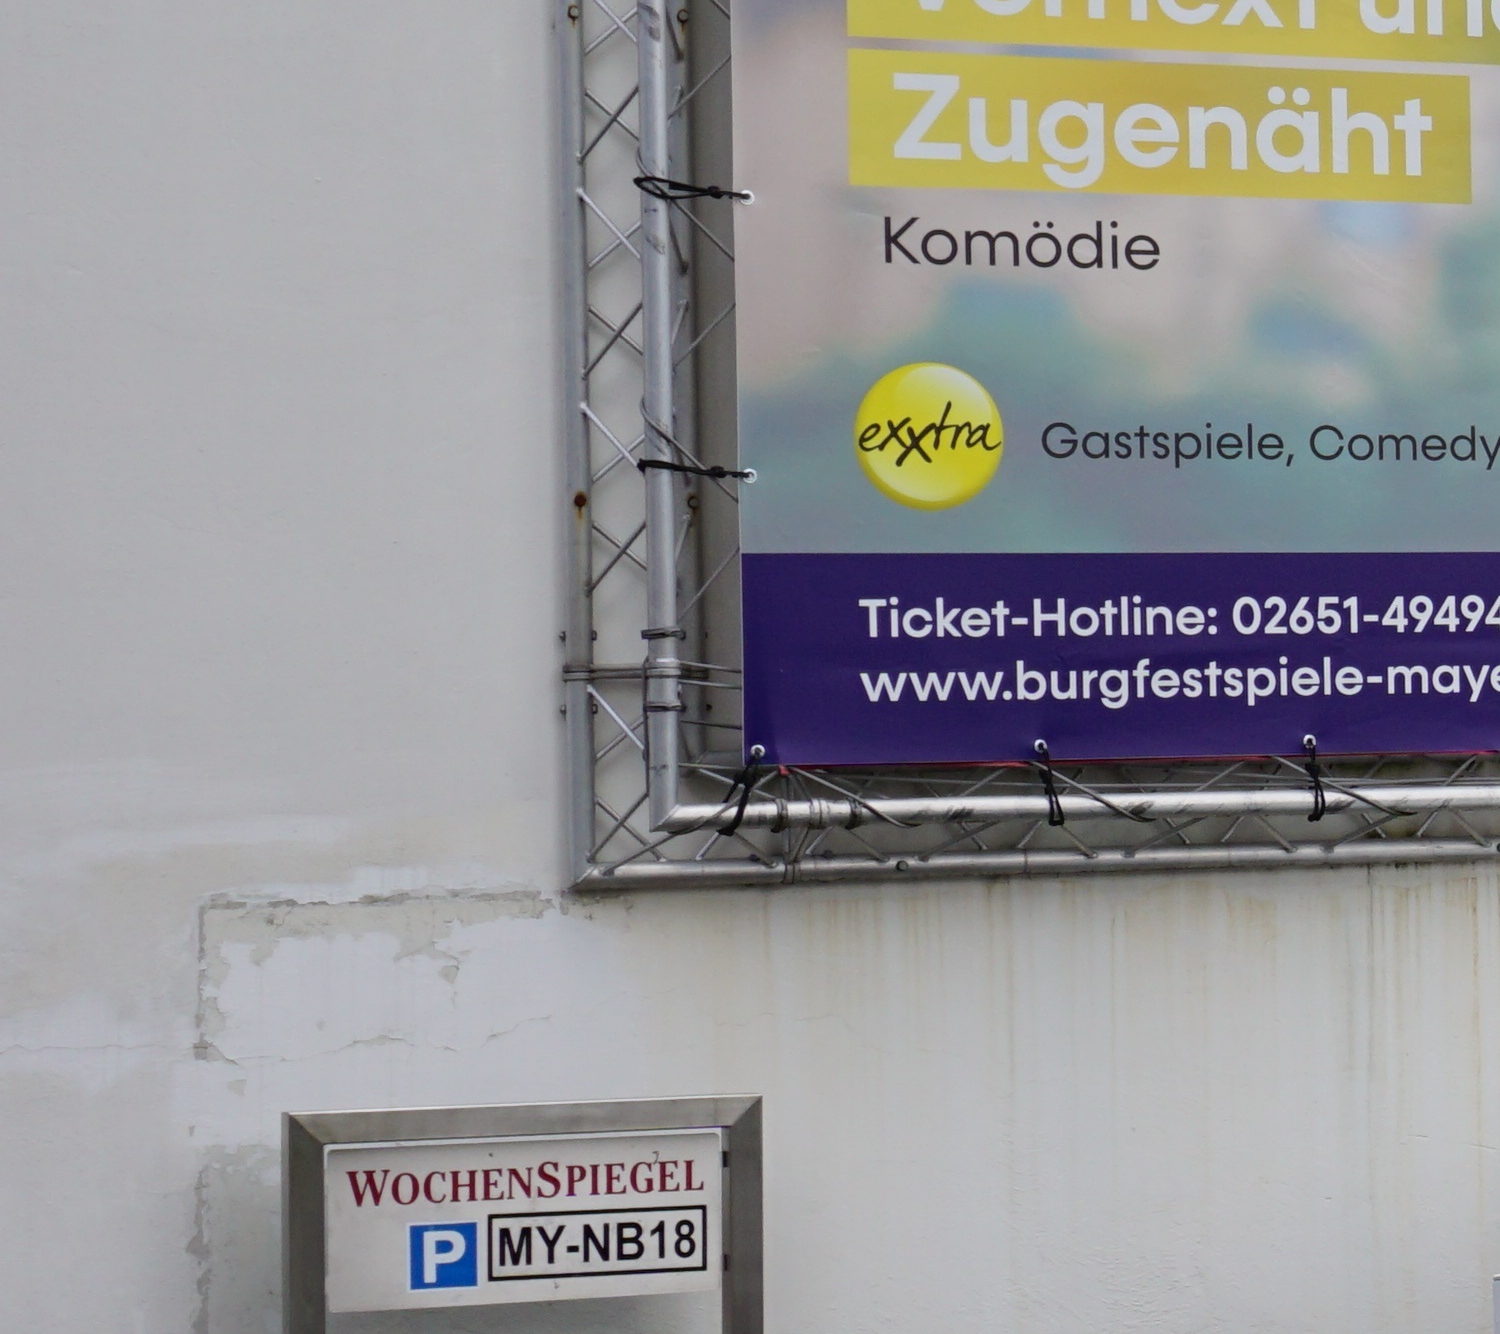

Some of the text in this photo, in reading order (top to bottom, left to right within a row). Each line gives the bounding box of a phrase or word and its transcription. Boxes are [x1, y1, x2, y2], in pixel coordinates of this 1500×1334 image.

[891, 73, 1433, 189] Zugenäht
[884, 216, 1160, 270] Komödie
[859, 401, 1001, 466] exxtra
[1042, 422, 1293, 468] Gastspiele,
[859, 595, 1217, 638] Ticket-Hotline:
[424, 1220, 696, 1283] P MY-NB18
